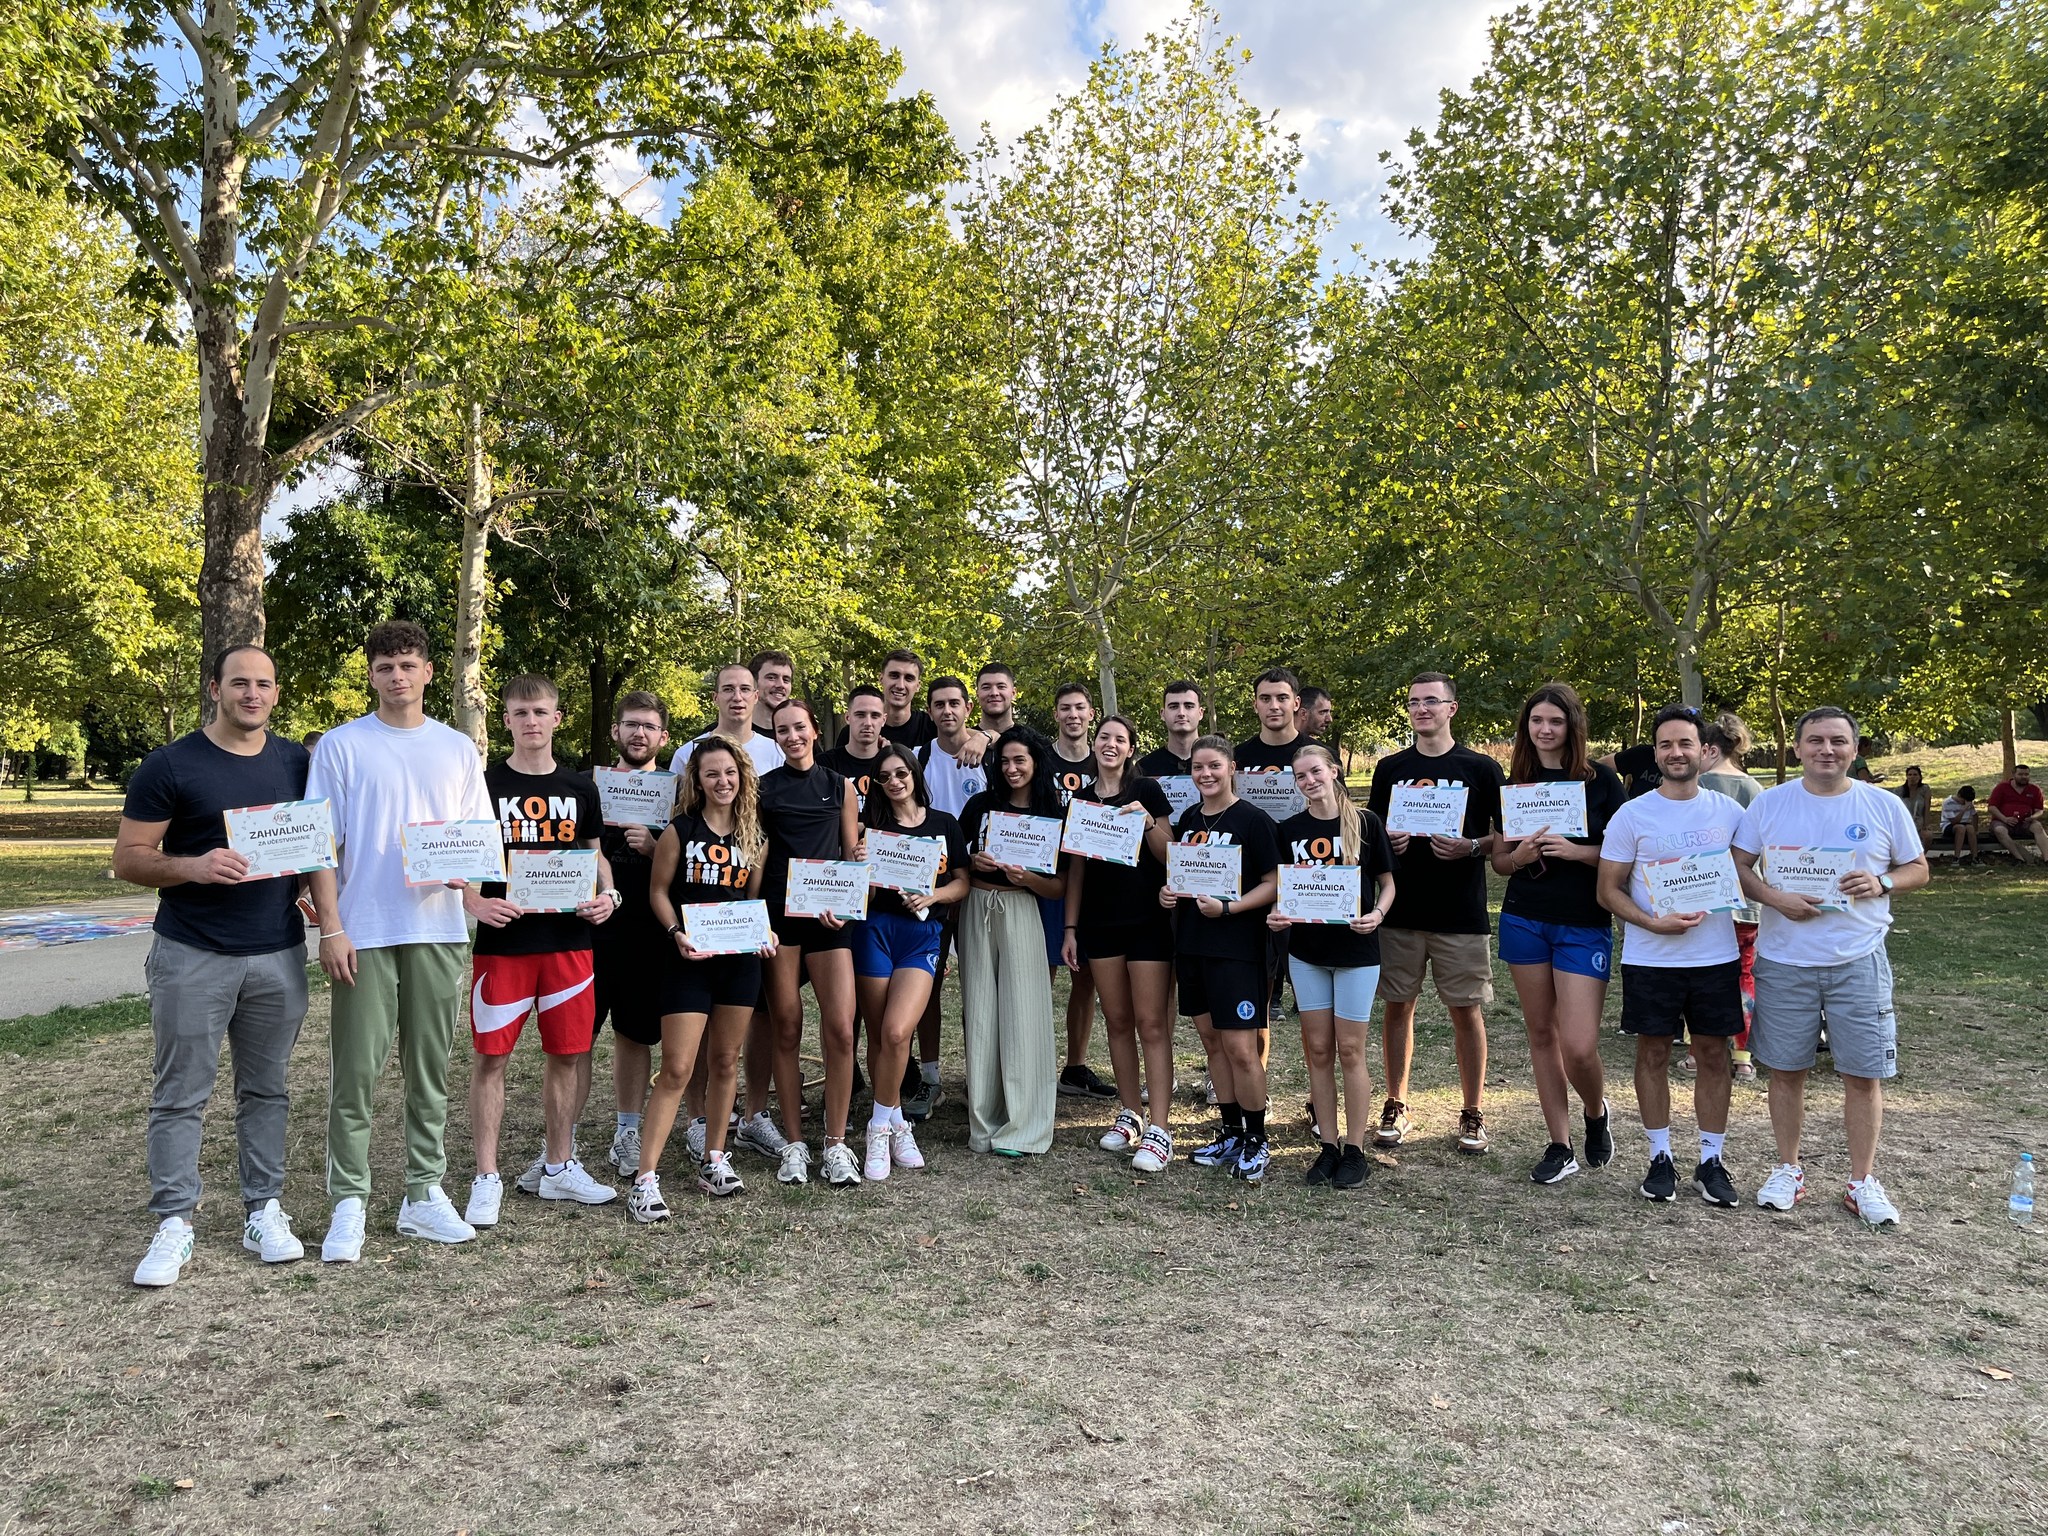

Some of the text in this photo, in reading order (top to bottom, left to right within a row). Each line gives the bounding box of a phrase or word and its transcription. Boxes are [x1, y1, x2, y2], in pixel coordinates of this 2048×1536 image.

[607, 786, 661, 798] ZAHVALNICA
[1246, 787, 1295, 795] ZAHVALNICA
[1402, 800, 1451, 809] ZAHVALNICA
[1516, 799, 1571, 809] ZAHVALNICA
[499, 796, 577, 824] KOM
[249, 823, 316, 840] ZAHVALNICA
[539, 820, 576, 842] 18
[1080, 818, 1129, 834] ZAHVALNICA
[999, 829, 1046, 842] ZAHVALNICA
[421, 839, 486, 850] ZAHVALNICA
[876, 848, 926, 863] ZAHVALNICA
[1179, 860, 1228, 869] ZAHVALNICA
[525, 870, 582, 879] ZAHVALNICA
[1777, 866, 1837, 876] ZAHVALNICA
[720, 865, 750, 889] 18
[1662, 870, 1721, 888] ZAHVALNICA
[802, 878, 855, 888] ZAHVALNICA
[1292, 883, 1346, 891] ZAHVALNICA
[700, 917, 754, 926] ZAHVALNICA
